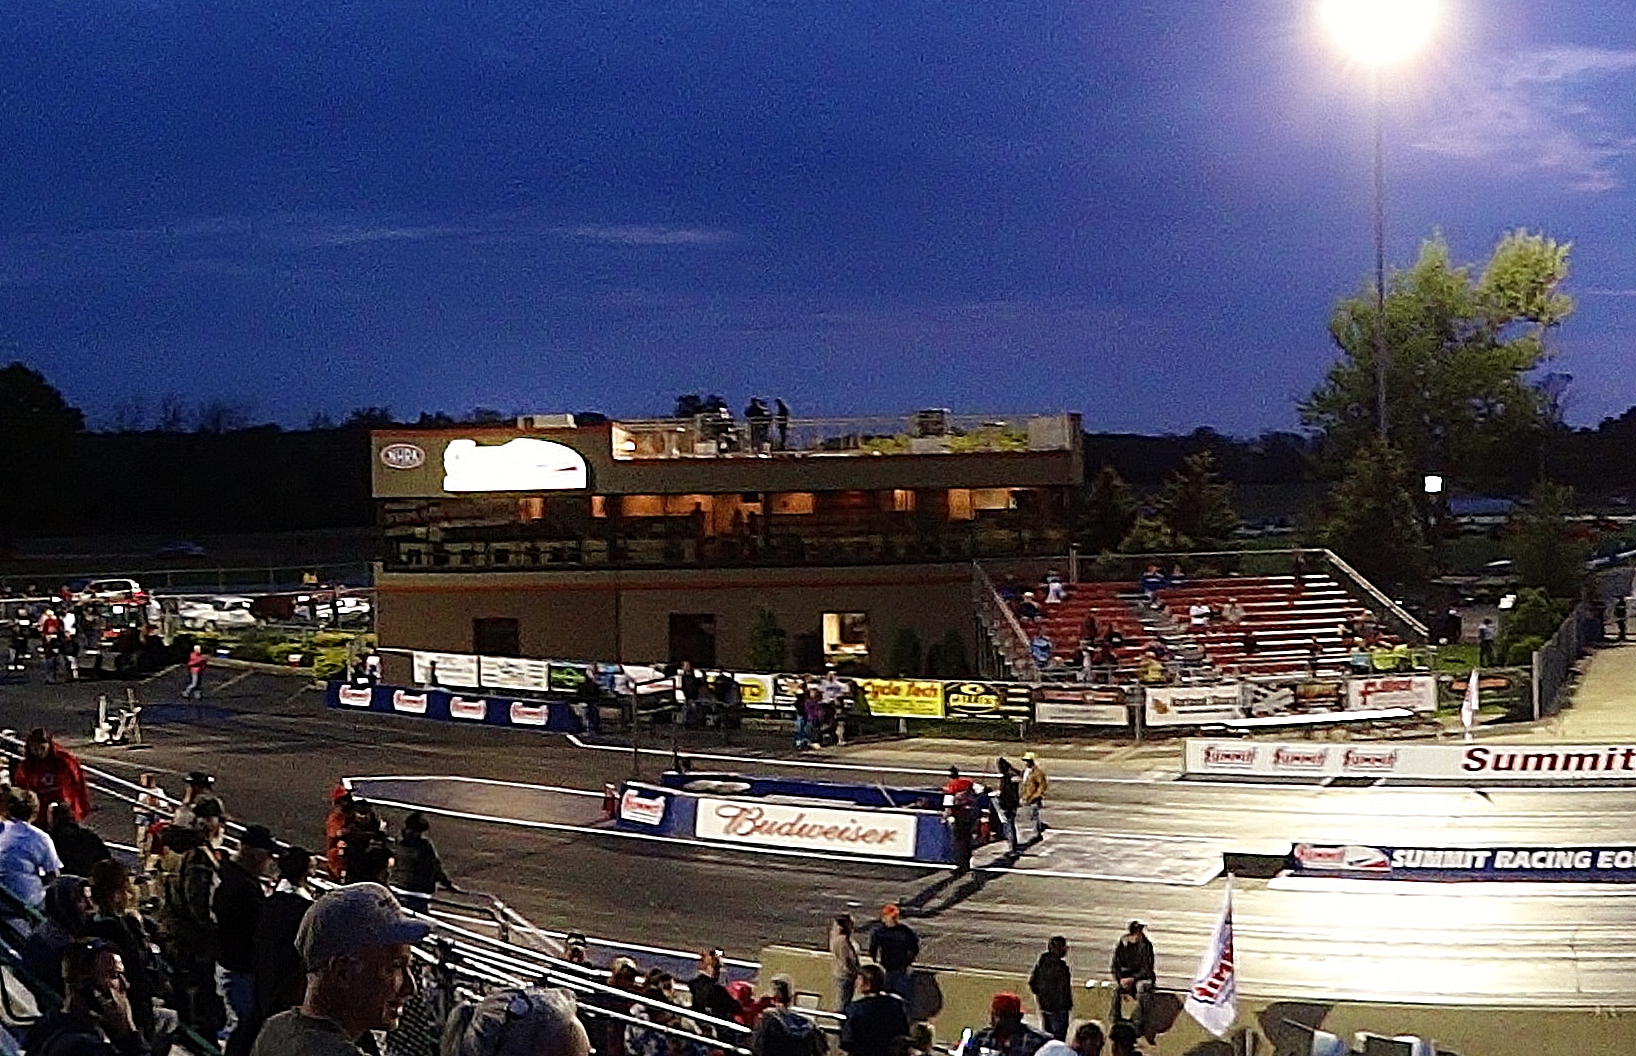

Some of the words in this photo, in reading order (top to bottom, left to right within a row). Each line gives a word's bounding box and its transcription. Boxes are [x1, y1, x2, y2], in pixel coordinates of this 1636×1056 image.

[906, 681, 938, 697] Tech
[714, 804, 898, 845] Budweiser
[1392, 849, 1492, 868] SUMMIT
[1493, 849, 1593, 869] RACING
